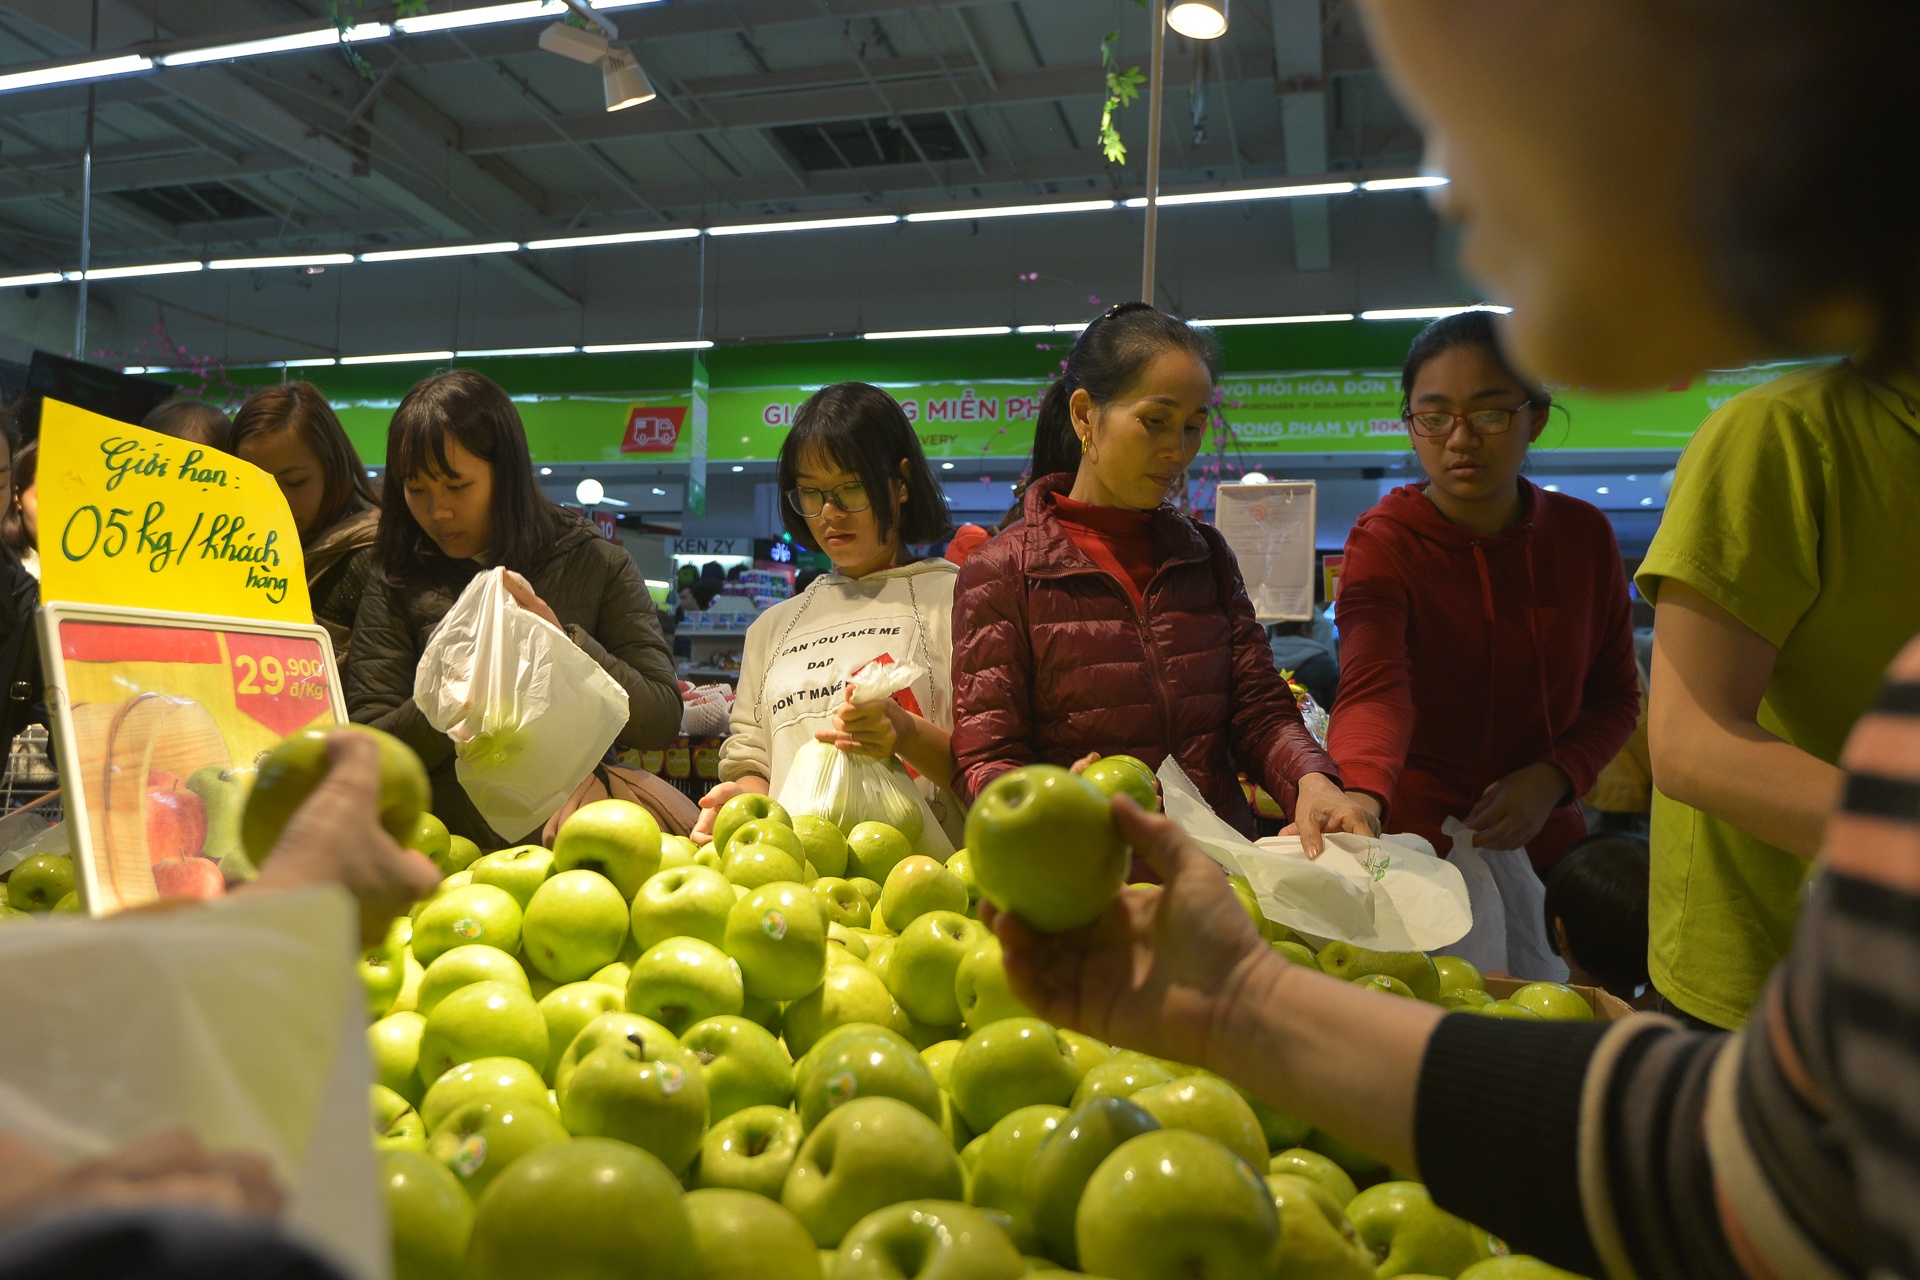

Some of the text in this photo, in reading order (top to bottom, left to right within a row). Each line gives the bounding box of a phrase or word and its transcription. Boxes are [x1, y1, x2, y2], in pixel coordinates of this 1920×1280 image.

[1391, 380, 1403, 394] T
[928, 388, 997, 421] MIỄN
[1007, 398, 1042, 420] PH
[1231, 421, 1283, 436] RONG
[921, 433, 957, 446] VERY
[101, 436, 171, 492] Giới
[674, 539, 735, 553] KEN ZY
[246, 565, 288, 604] hàng
[782, 626, 901, 656] CAN YOU TAKE ME
[807, 657, 834, 670] DAD
[290, 682, 324, 700] đ/Kg
[810, 680, 842, 700] MAKE
